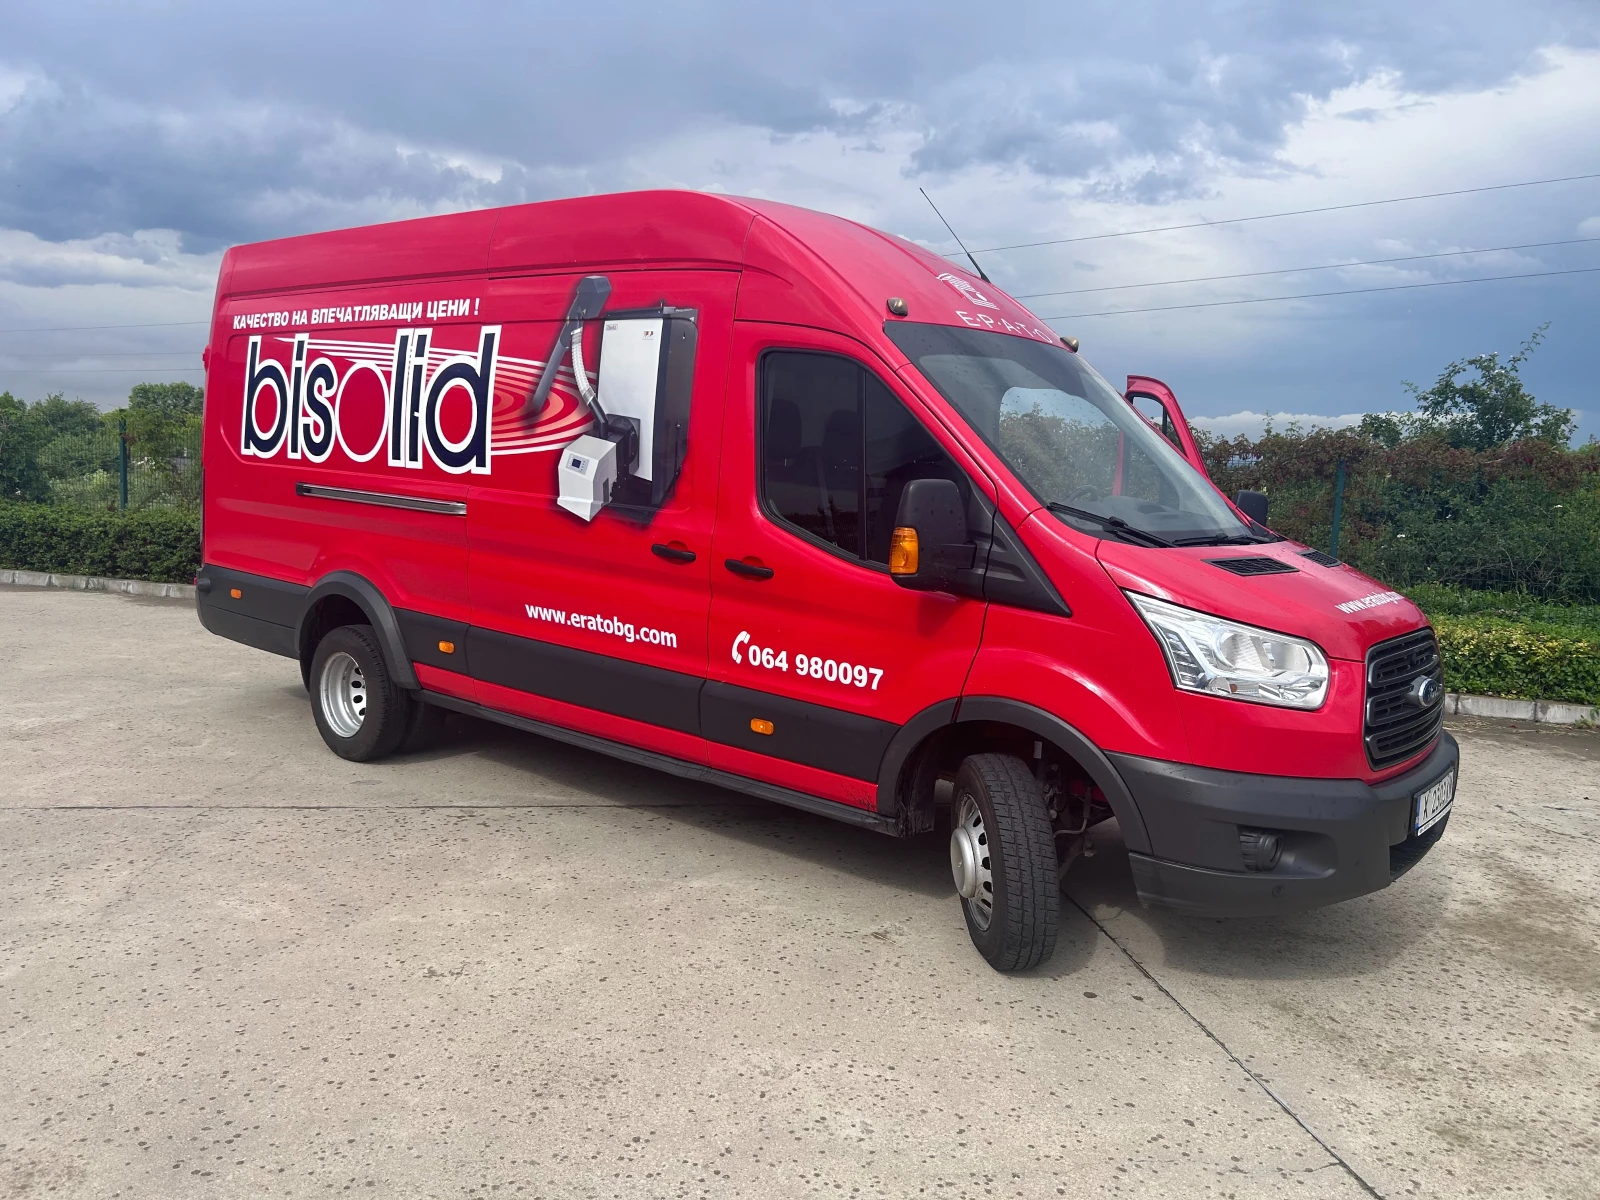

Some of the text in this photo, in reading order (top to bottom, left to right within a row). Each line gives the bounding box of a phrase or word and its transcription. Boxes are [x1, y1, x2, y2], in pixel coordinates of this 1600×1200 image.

[233, 311, 289, 329] КАЧЕСТВО
[291, 310, 308, 326] НА
[311, 301, 423, 325] ВПЕЧАТЛЯВАЩИ
[426, 298, 470, 321] ЦЕНИ
[241, 325, 502, 475] bisolid
[525, 604, 678, 648] www.eratobg.com
[748, 645, 884, 690] 064 980097
